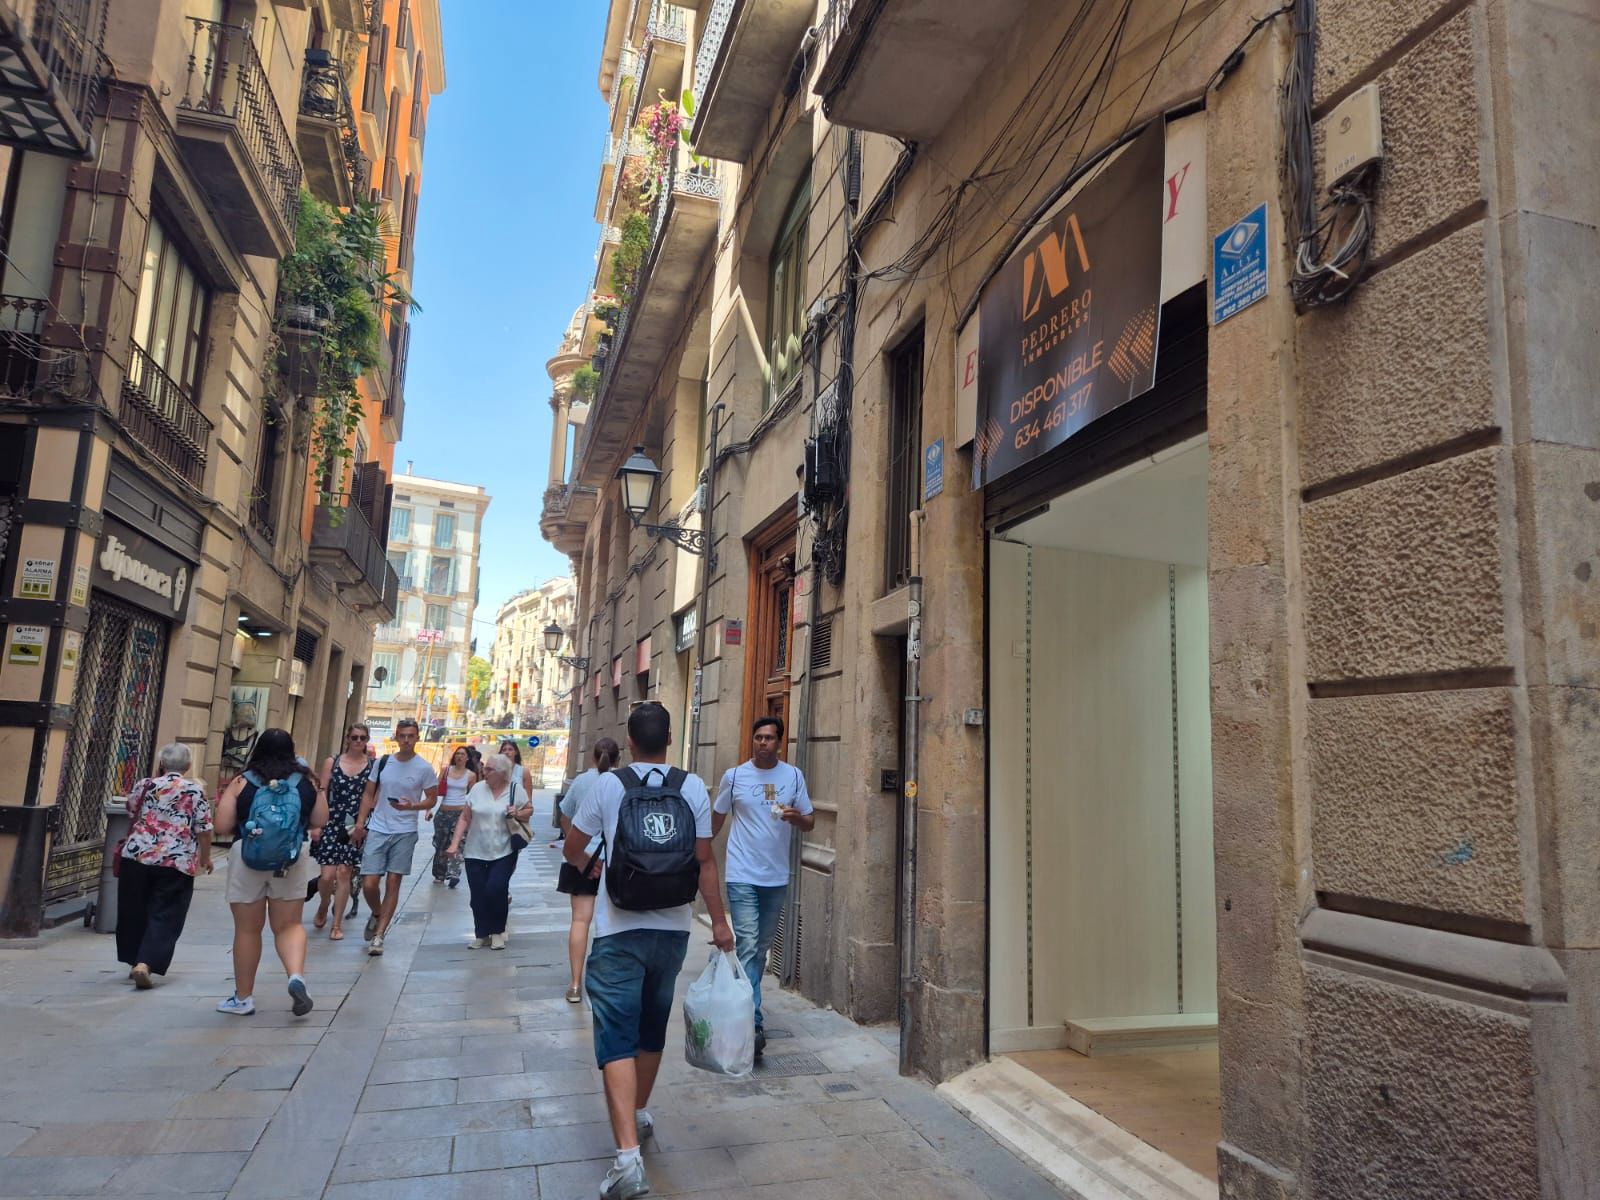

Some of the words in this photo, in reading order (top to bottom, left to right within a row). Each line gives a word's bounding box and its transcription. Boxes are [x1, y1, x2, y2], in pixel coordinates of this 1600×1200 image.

[1022, 289, 1092, 356] PEDRERO
[1023, 311, 1089, 368] INMUEBLES
[1010, 340, 1104, 424] DISPONIBLE
[1014, 418, 1041, 449] 634
[1043, 401, 1066, 432] 461
[1068, 382, 1093, 416] 317
[24, 567, 52, 575] ALARMA
